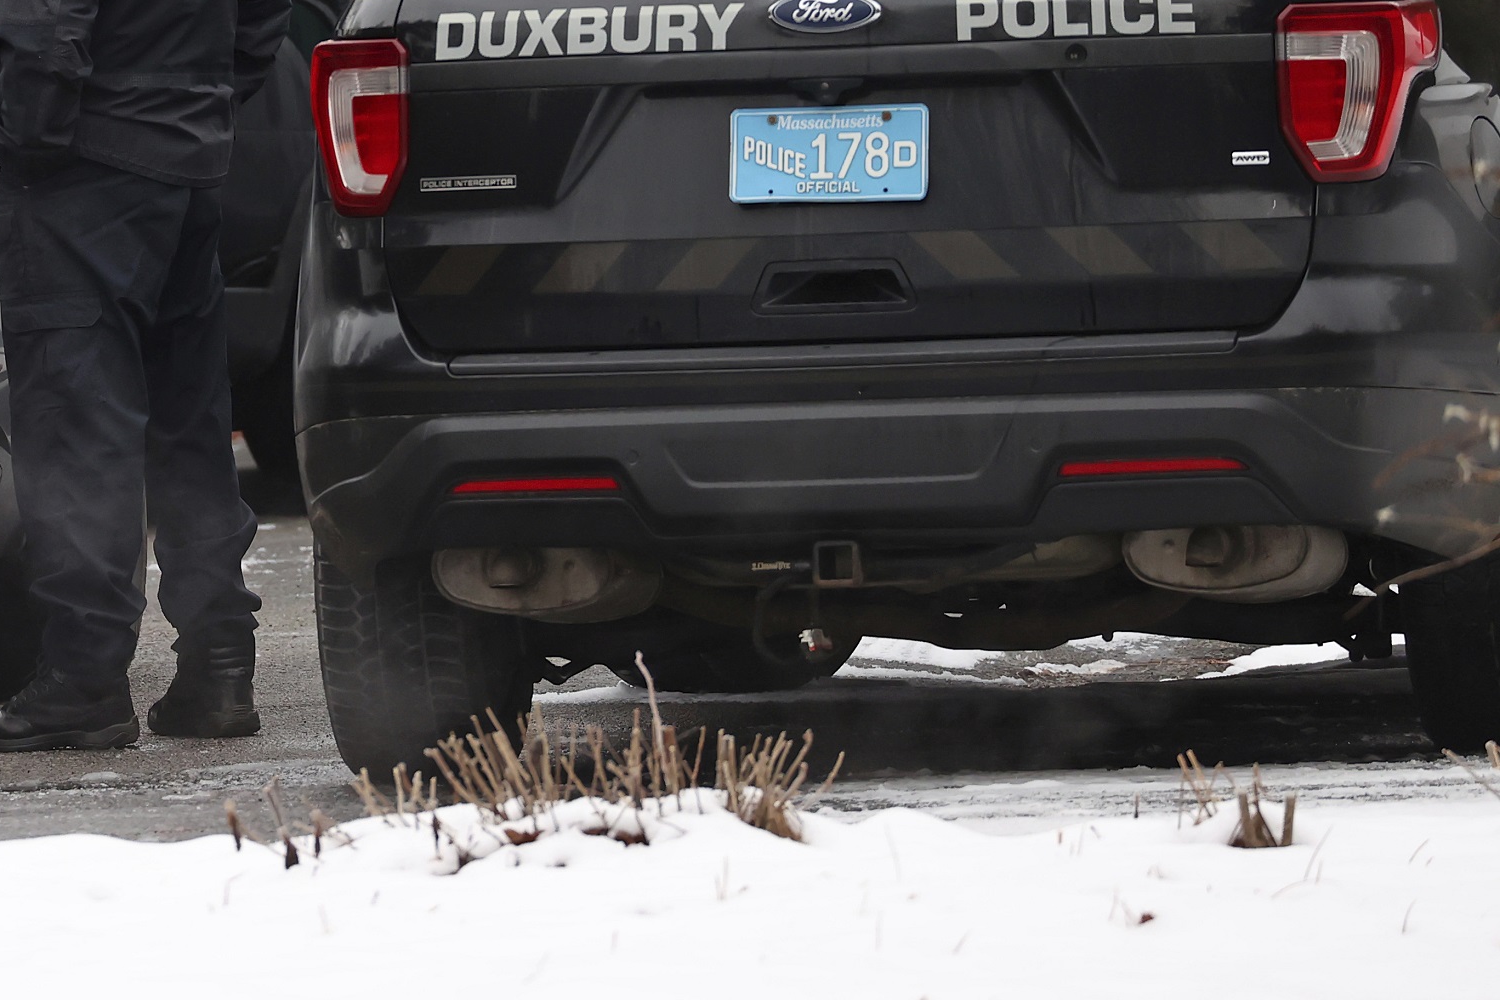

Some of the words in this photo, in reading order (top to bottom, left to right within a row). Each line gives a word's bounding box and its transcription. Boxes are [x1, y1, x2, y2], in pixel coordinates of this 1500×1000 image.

[435, 2, 745, 61] DUXBURY
[777, 114, 884, 131] Massachusetts
[744, 136, 807, 179] POLICE
[423, 180, 452, 189] POLICE
[454, 177, 514, 188] INTERCEPTOR
[796, 181, 861, 194] OFFICIAL
